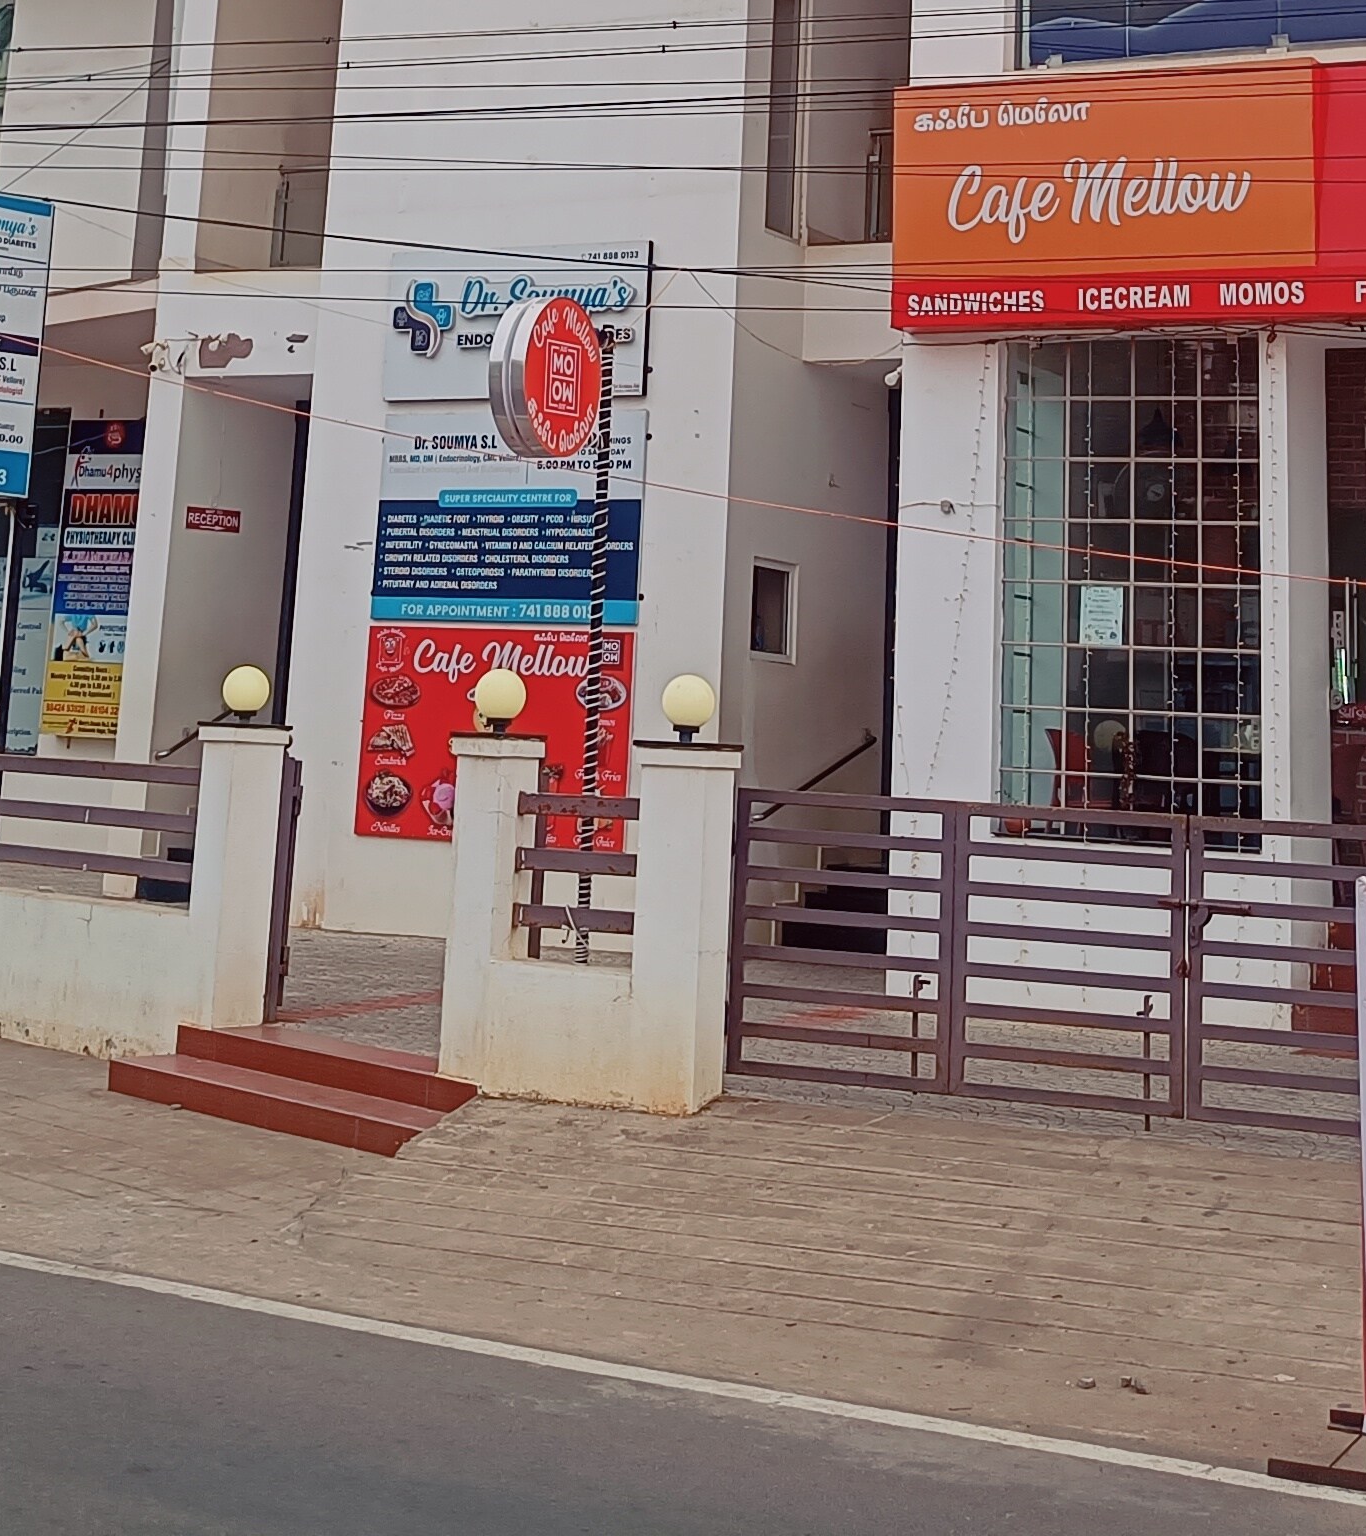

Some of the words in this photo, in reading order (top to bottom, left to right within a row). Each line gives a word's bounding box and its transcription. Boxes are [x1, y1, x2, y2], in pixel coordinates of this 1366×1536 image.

[913, 102, 989, 132] கஃபே
[947, 164, 1061, 244] Cafe
[1062, 156, 1252, 227] Mellow
[3, 237, 37, 249] DIABETES
[587, 252, 601, 260] 741
[461, 278, 499, 314] Dr.
[907, 290, 1045, 316] SANDWICHES
[1077, 284, 1191, 311] ICECREAM
[1219, 281, 1305, 306] MOMOS
[533, 308, 559, 348] Cafe
[562, 306, 598, 363] Mellow
[0, 356, 17, 372] S.L
[414, 436, 428, 450] Dr.
[431, 435, 477, 450] SOUMYA
[480, 434, 498, 449] S.L
[444, 493, 471, 502] SUPER
[472, 493, 519, 503] SPECIALITY
[520, 493, 553, 502] CENTRE
[554, 494, 571, 502] FOR
[69, 493, 140, 526] DHAM
[188, 512, 239, 527] RECEPTION
[65, 530, 121, 546] PHYSIOTHERAPY
[400, 603, 423, 616] FOR
[425, 604, 509, 618] APPOINTMENT
[519, 604, 542, 618] 741
[544, 604, 570, 618] 888
[413, 638, 476, 683] Cafe
[481, 641, 589, 677] Mellow
